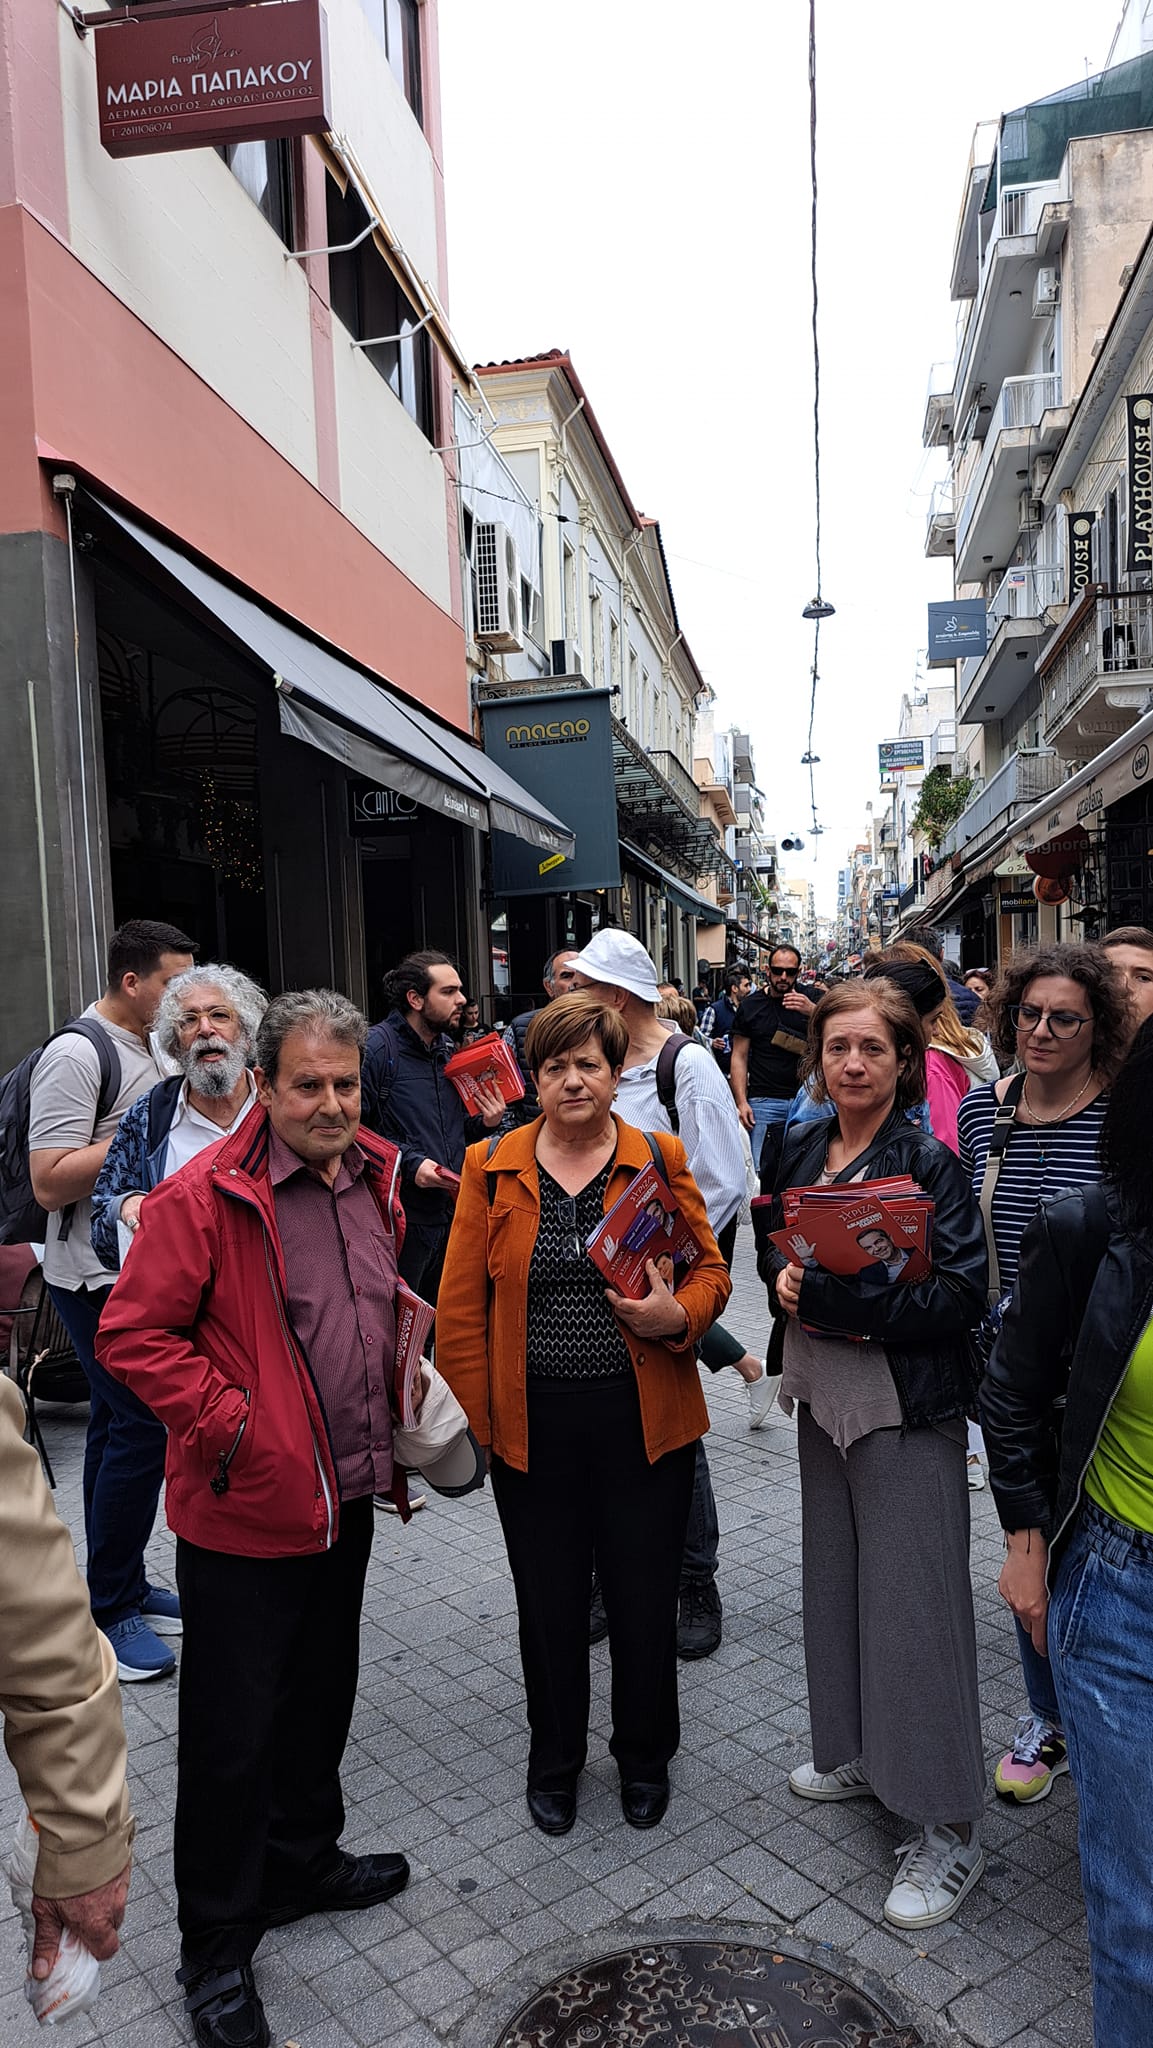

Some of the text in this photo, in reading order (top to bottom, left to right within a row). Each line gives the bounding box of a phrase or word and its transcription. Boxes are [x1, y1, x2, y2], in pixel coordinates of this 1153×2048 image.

[107, 60, 312, 105] ΜΑΡΙΑ ΠΑΠΑΚΟΥ
[108, 101, 201, 120] ΔΕΡΜΑΤΟΛΟΓΟΣ
[210, 86, 314, 107] ΑΦΡΟΔΙΣΙΟΛΟΓΟΣ
[1133, 424, 1152, 562] PLAYHOUSE
[506, 719, 590, 742] macao
[838, 1203, 877, 1222] ΣΥΡΙΖΑ
